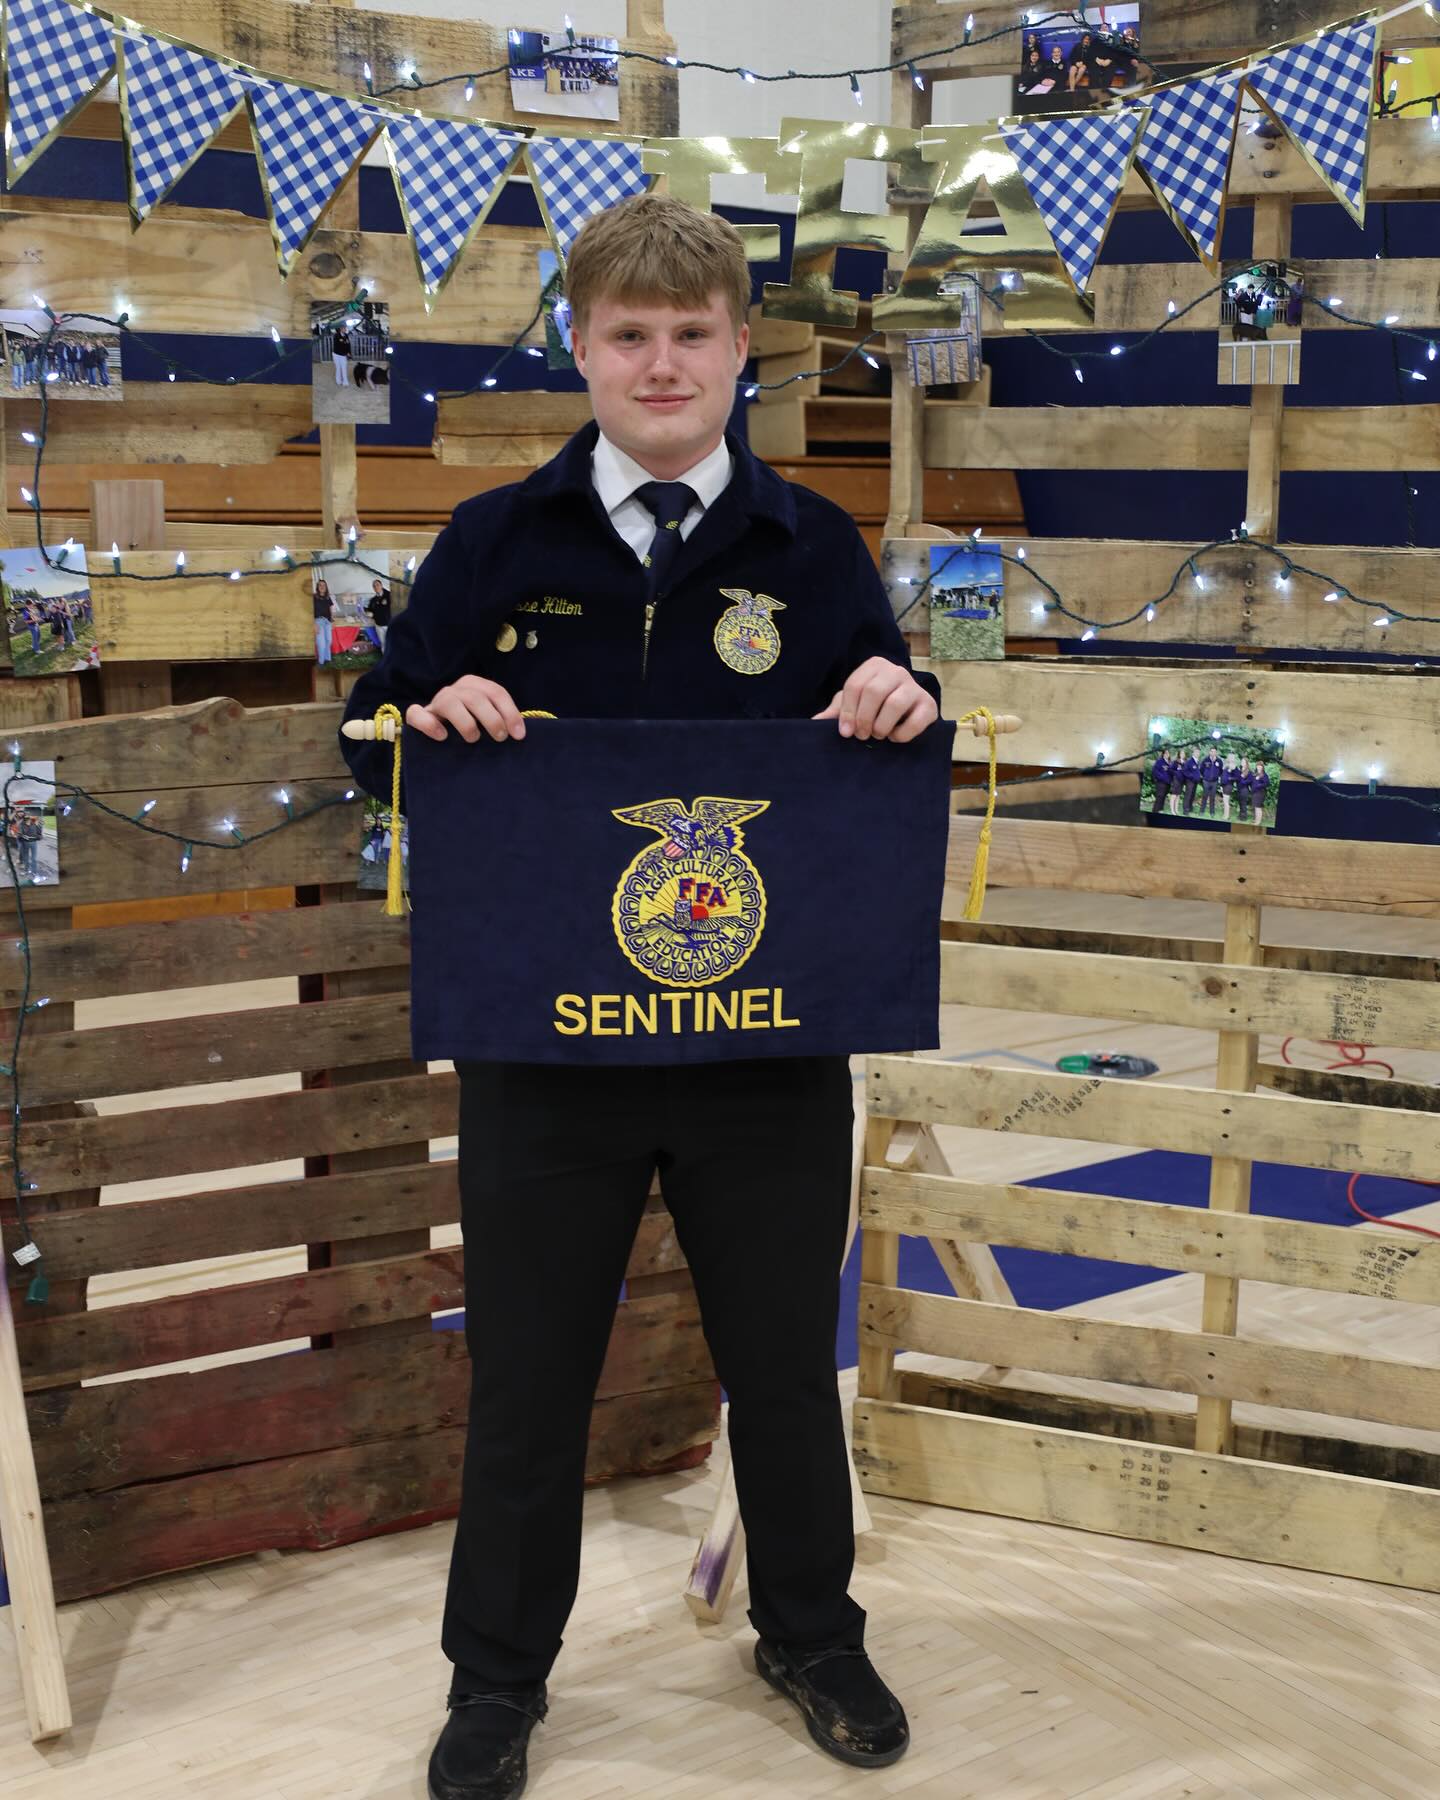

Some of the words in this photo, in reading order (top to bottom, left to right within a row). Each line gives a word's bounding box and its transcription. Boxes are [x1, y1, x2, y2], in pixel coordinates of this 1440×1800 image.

[541, 596, 583, 615] Hilton
[739, 625, 761, 638] FFA
[645, 859, 737, 901] AGRICULTURAL
[678, 877, 728, 908] FFA
[653, 932, 731, 962] EDUCATION
[553, 987, 801, 1036] SENTINEL
